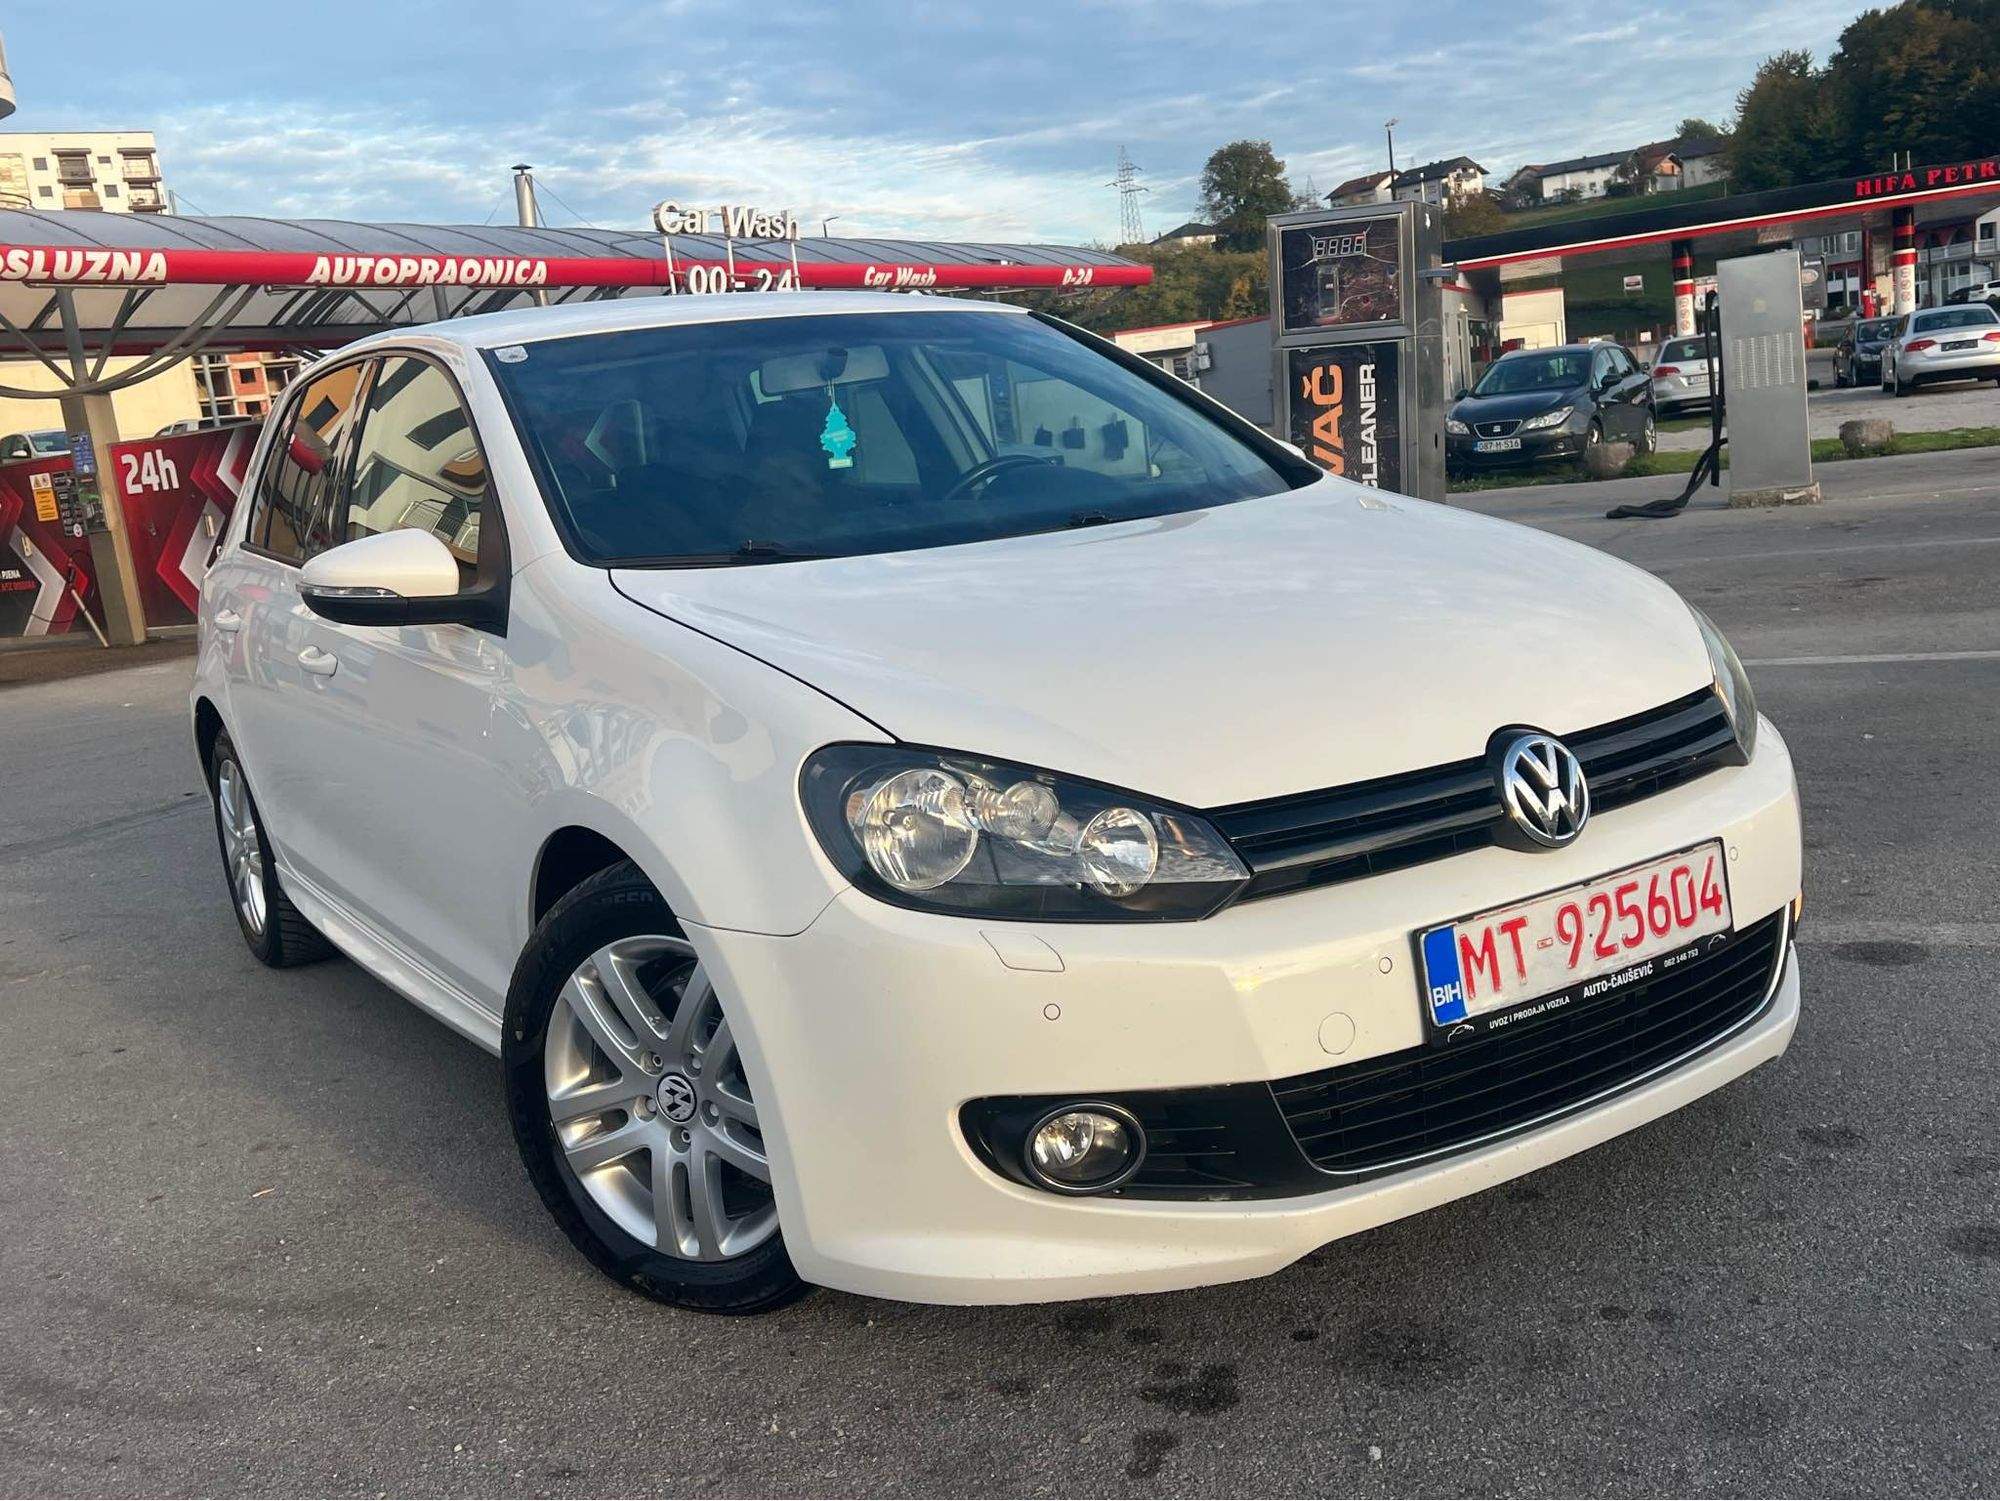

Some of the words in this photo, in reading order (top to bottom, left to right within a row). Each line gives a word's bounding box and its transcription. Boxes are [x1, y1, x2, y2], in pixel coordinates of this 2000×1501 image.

[1856, 171, 1916, 196] HIFA
[1926, 161, 2000, 186] PETR
[655, 200, 711, 235] Car
[721, 203, 801, 240] Wash
[0, 249, 168, 282] SLUZNA
[305, 256, 547, 285] AUTOPRAONICA
[864, 266, 893, 287] Car
[896, 267, 938, 287] Wash
[121, 449, 180, 495] 24h
[1432, 980, 1462, 1007] BIH
[1489, 1015, 1509, 1030] UVOZ
[1513, 1003, 1546, 1022] PRODAJA
[1545, 995, 1571, 1010] VOZILA
[1583, 960, 1654, 999] AUTO-ČAUŠEVIĆ
